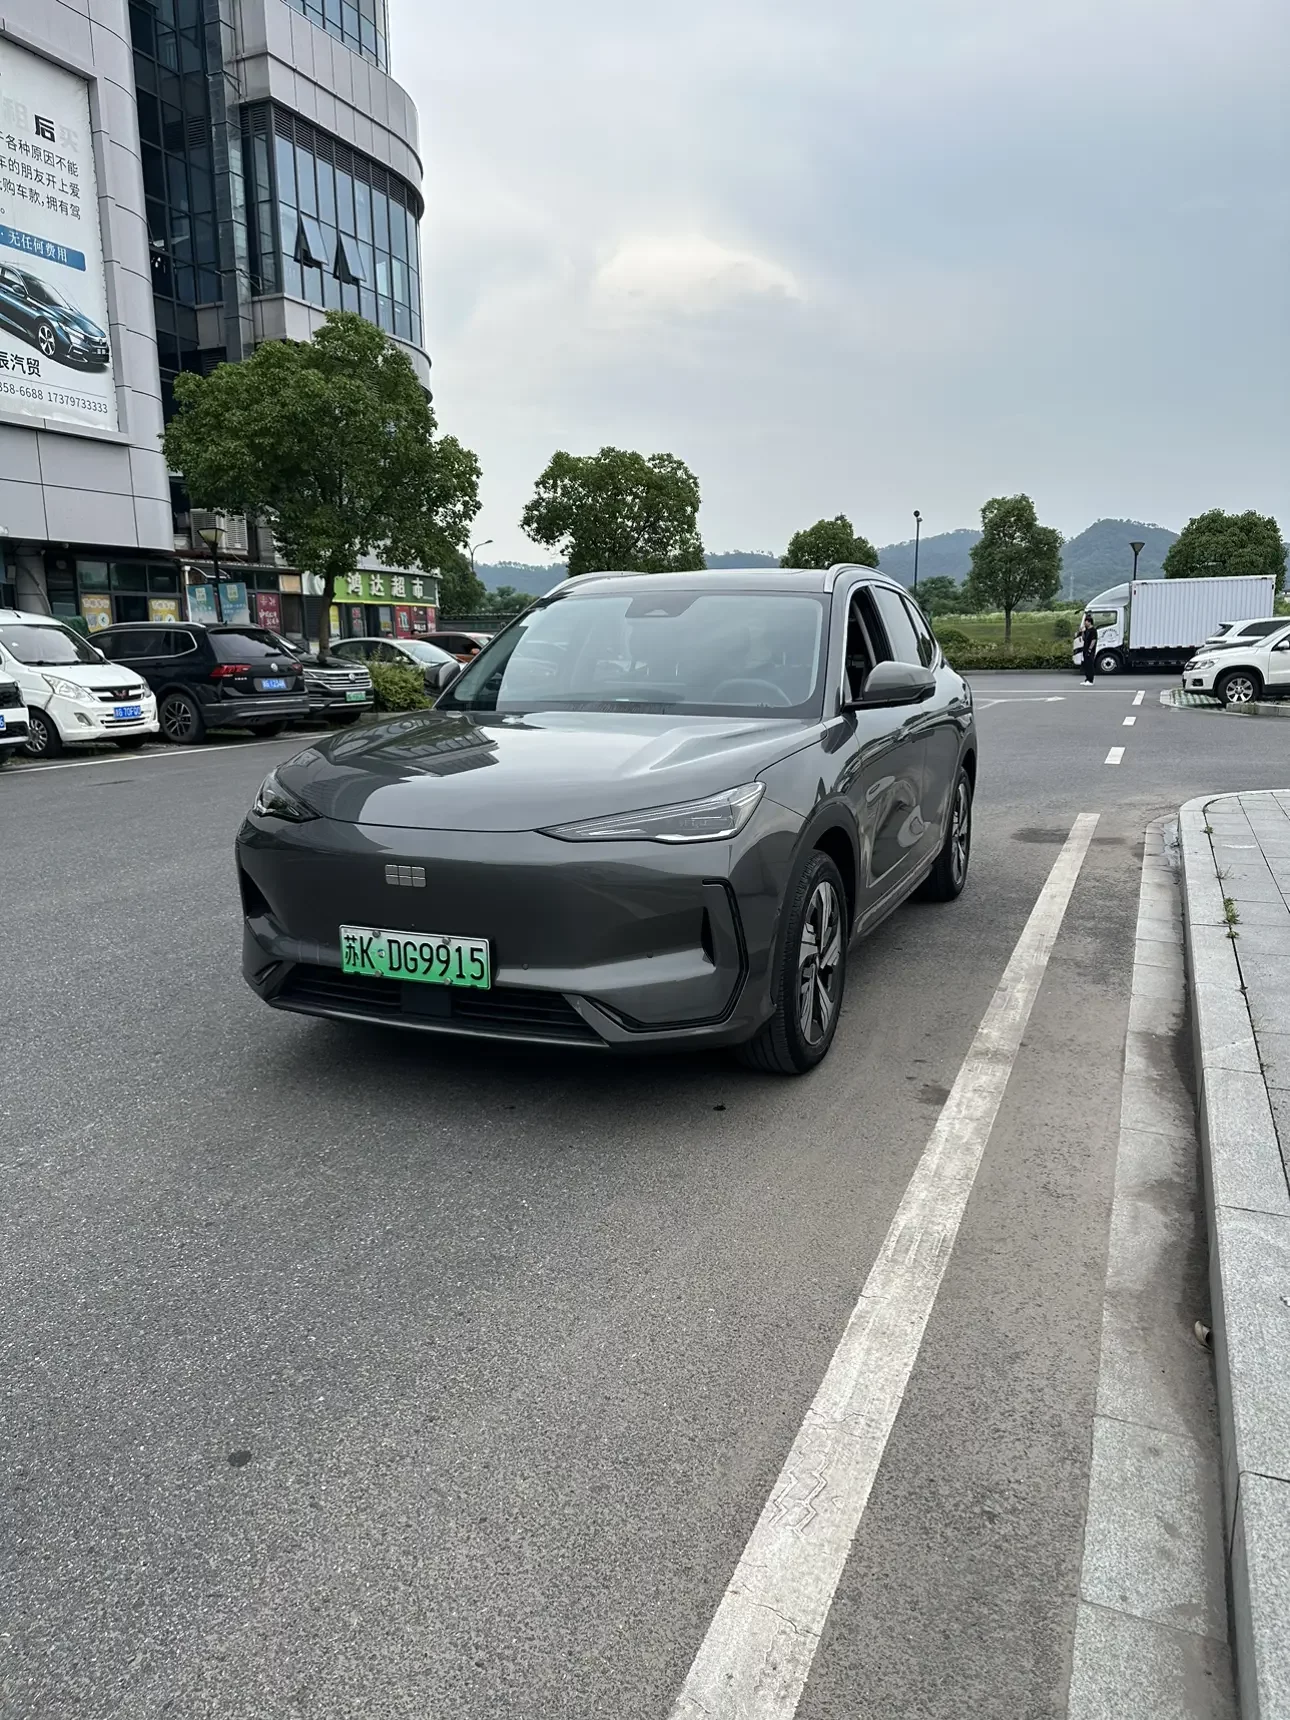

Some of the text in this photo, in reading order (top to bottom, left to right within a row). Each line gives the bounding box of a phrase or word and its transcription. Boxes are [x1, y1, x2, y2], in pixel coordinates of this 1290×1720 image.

[0, 177, 80, 220] 购车款,拥有驾
[47, 391, 108, 413] 17379733333
[347, 571, 424, 599] 鸿达超市
